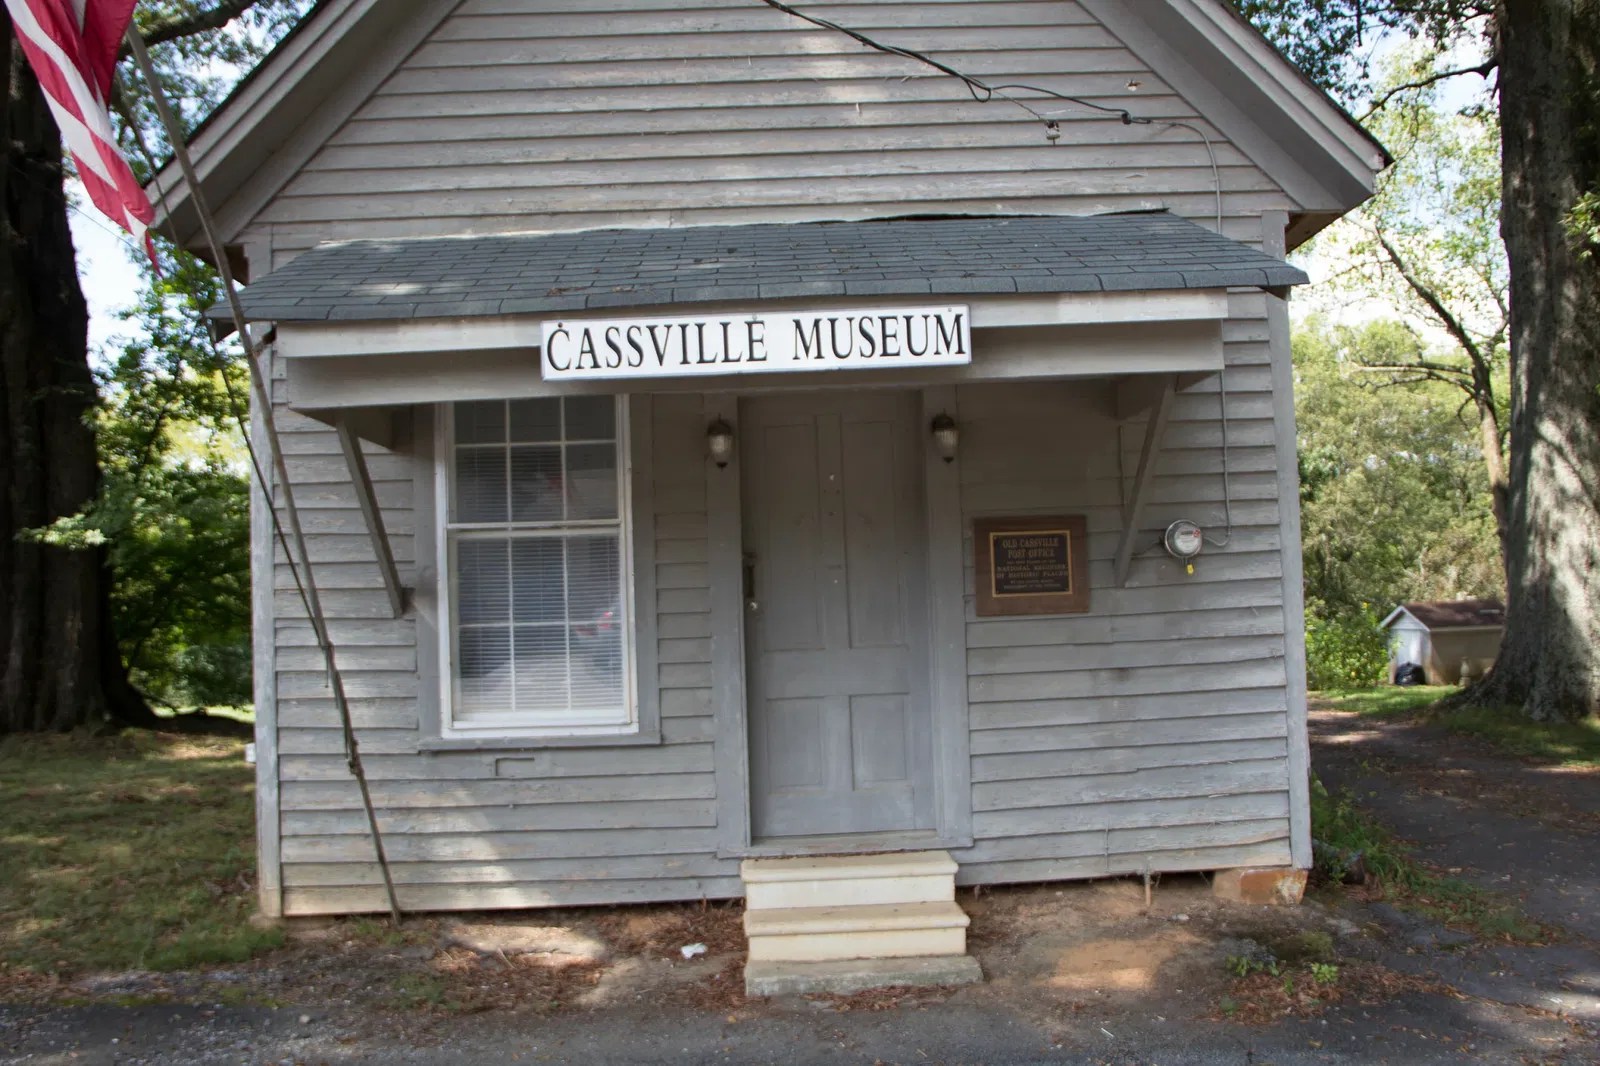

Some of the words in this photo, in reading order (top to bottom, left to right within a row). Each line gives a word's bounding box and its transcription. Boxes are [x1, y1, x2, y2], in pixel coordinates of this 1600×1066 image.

[546, 320, 768, 371] CASSVILLE
[792, 313, 966, 361] MUSEUM
[1003, 539, 1017, 548] OLD
[1020, 537, 1059, 548] CASSVILLE
